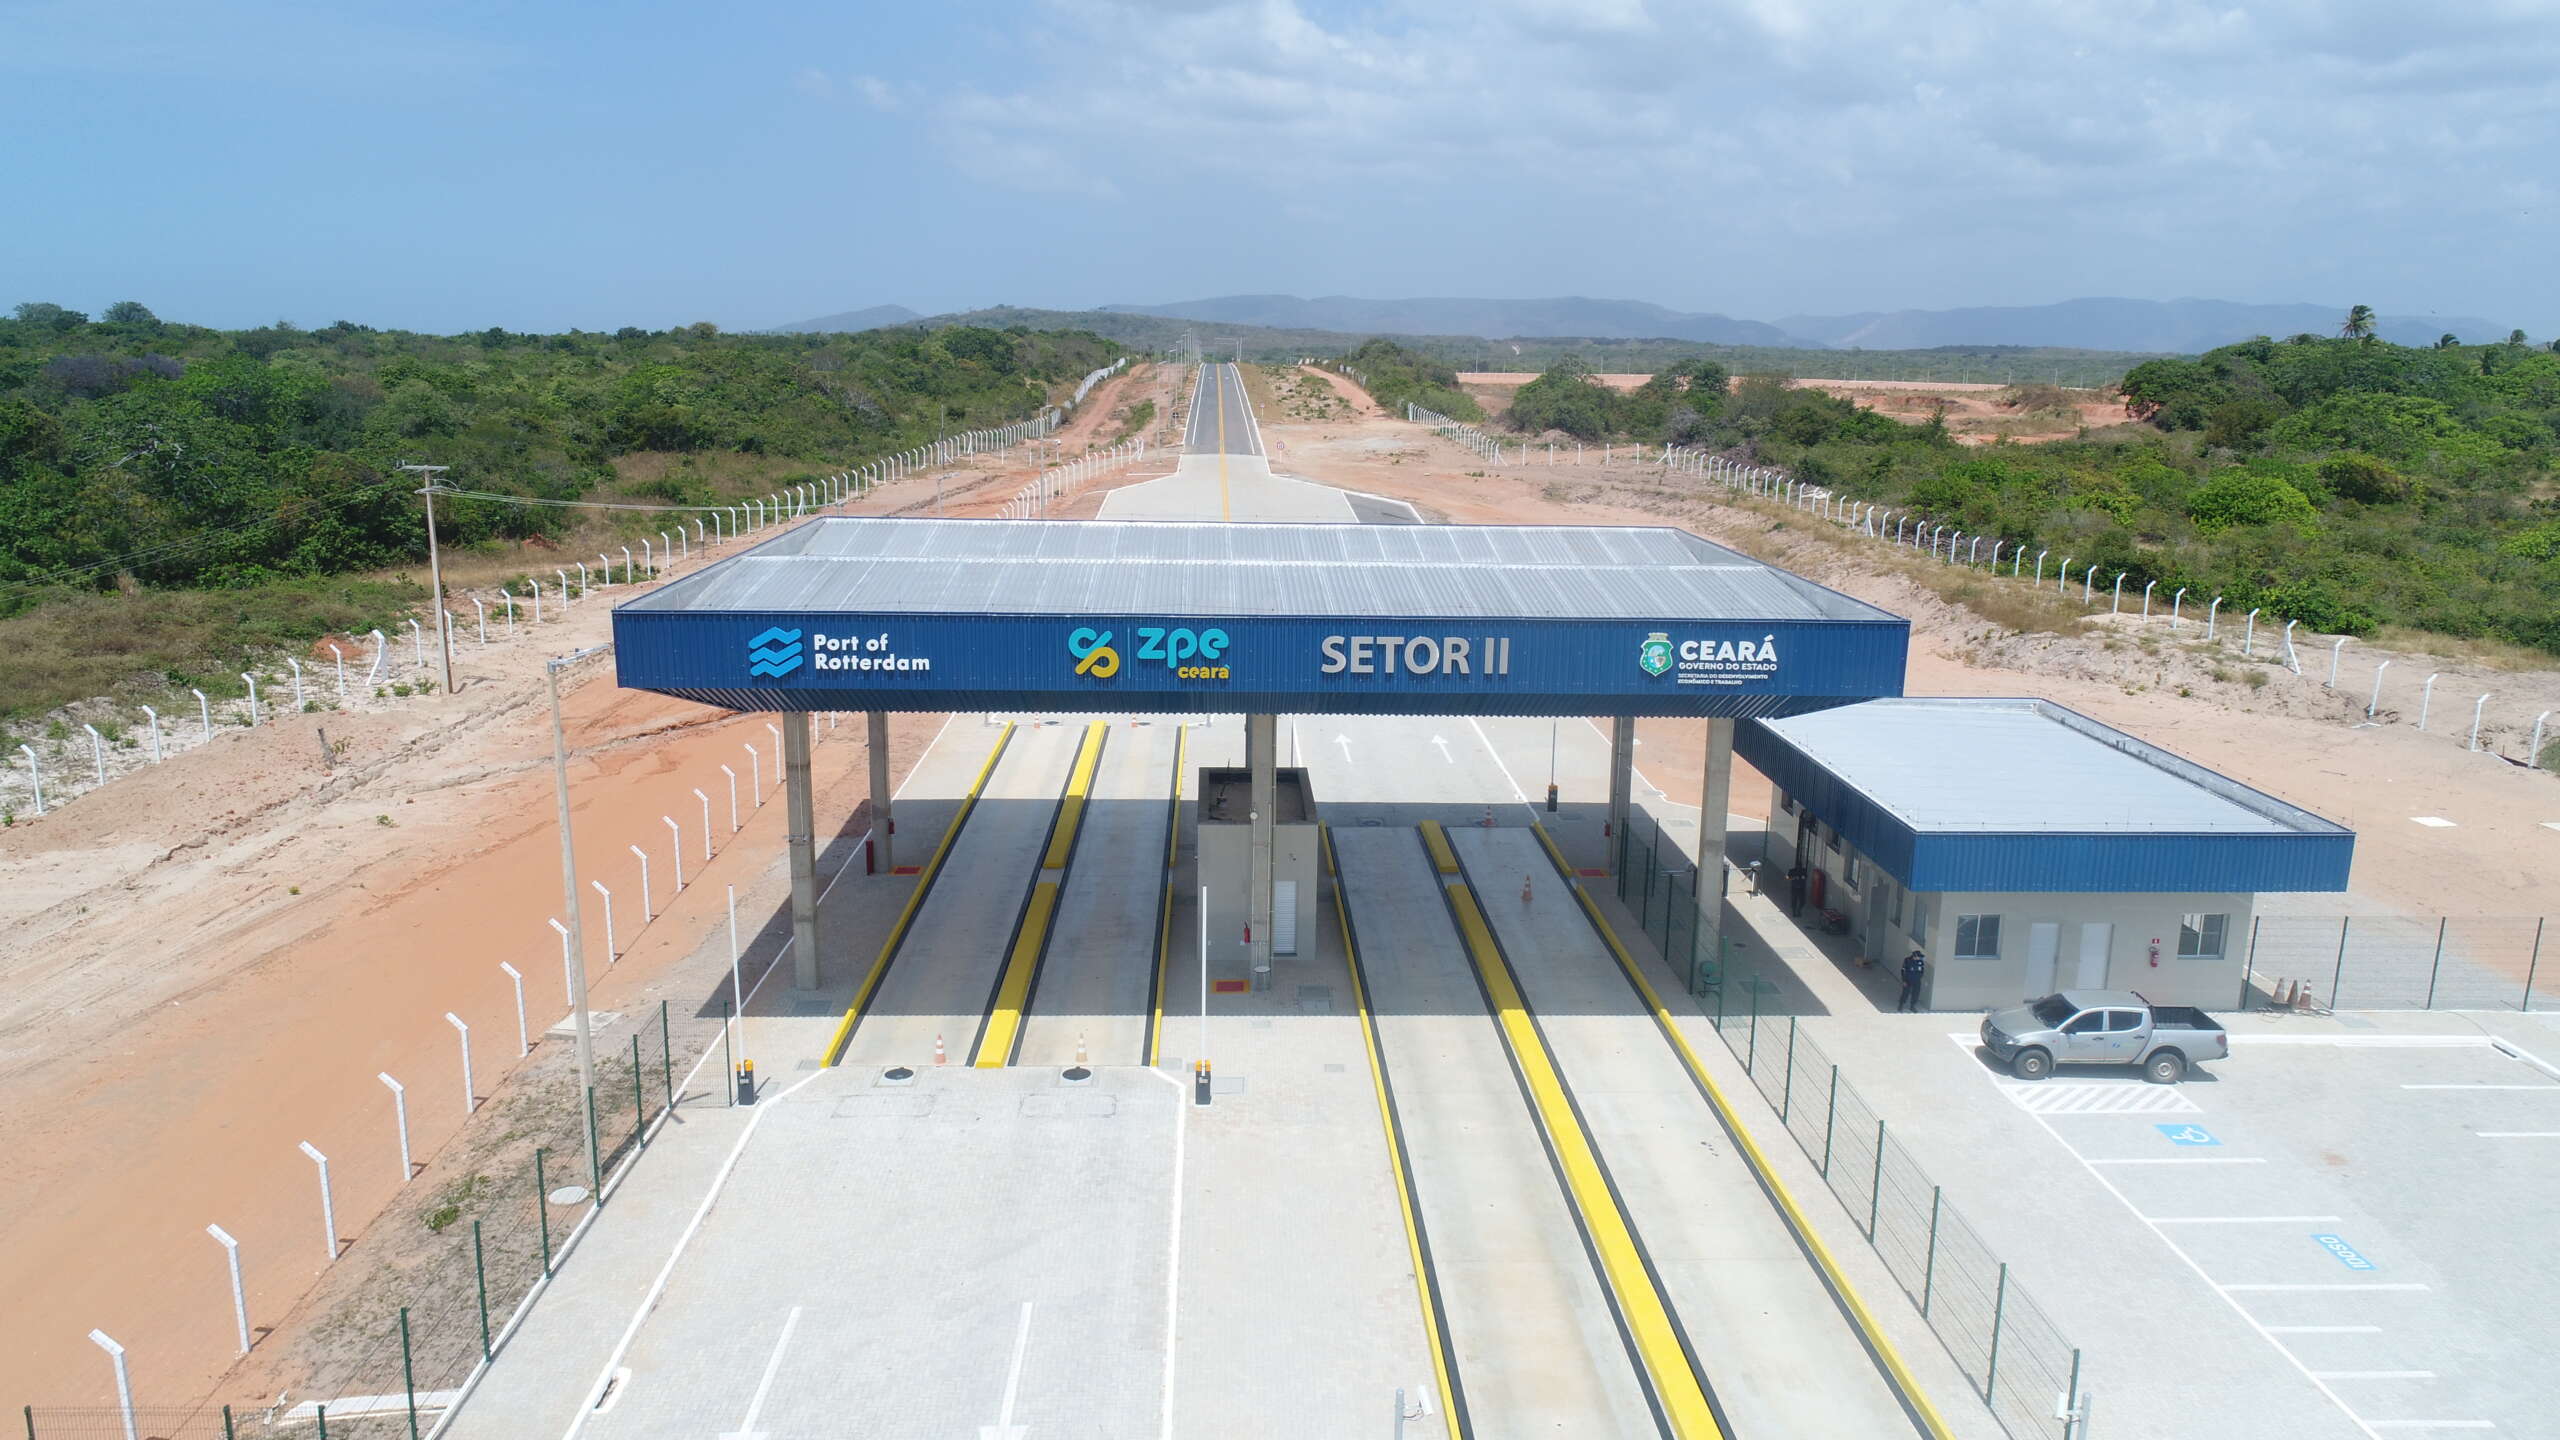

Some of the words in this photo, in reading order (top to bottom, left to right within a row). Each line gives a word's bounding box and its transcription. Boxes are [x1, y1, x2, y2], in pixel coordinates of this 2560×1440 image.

[814, 634, 859, 651] Port
[866, 632, 888, 651] of
[1137, 627, 1230, 669] zpe
[1320, 635, 1471, 674] SETOR
[1483, 637, 1510, 675] II
[1679, 634, 1778, 662] CEARÁ
[814, 653, 930, 671] Rotterdam
[1679, 662, 1724, 670] GOVERNO
[1725, 662, 1740, 671] DO
[1741, 663, 1778, 671] ESTADO
[2319, 1236, 2371, 1268] IDOSO
